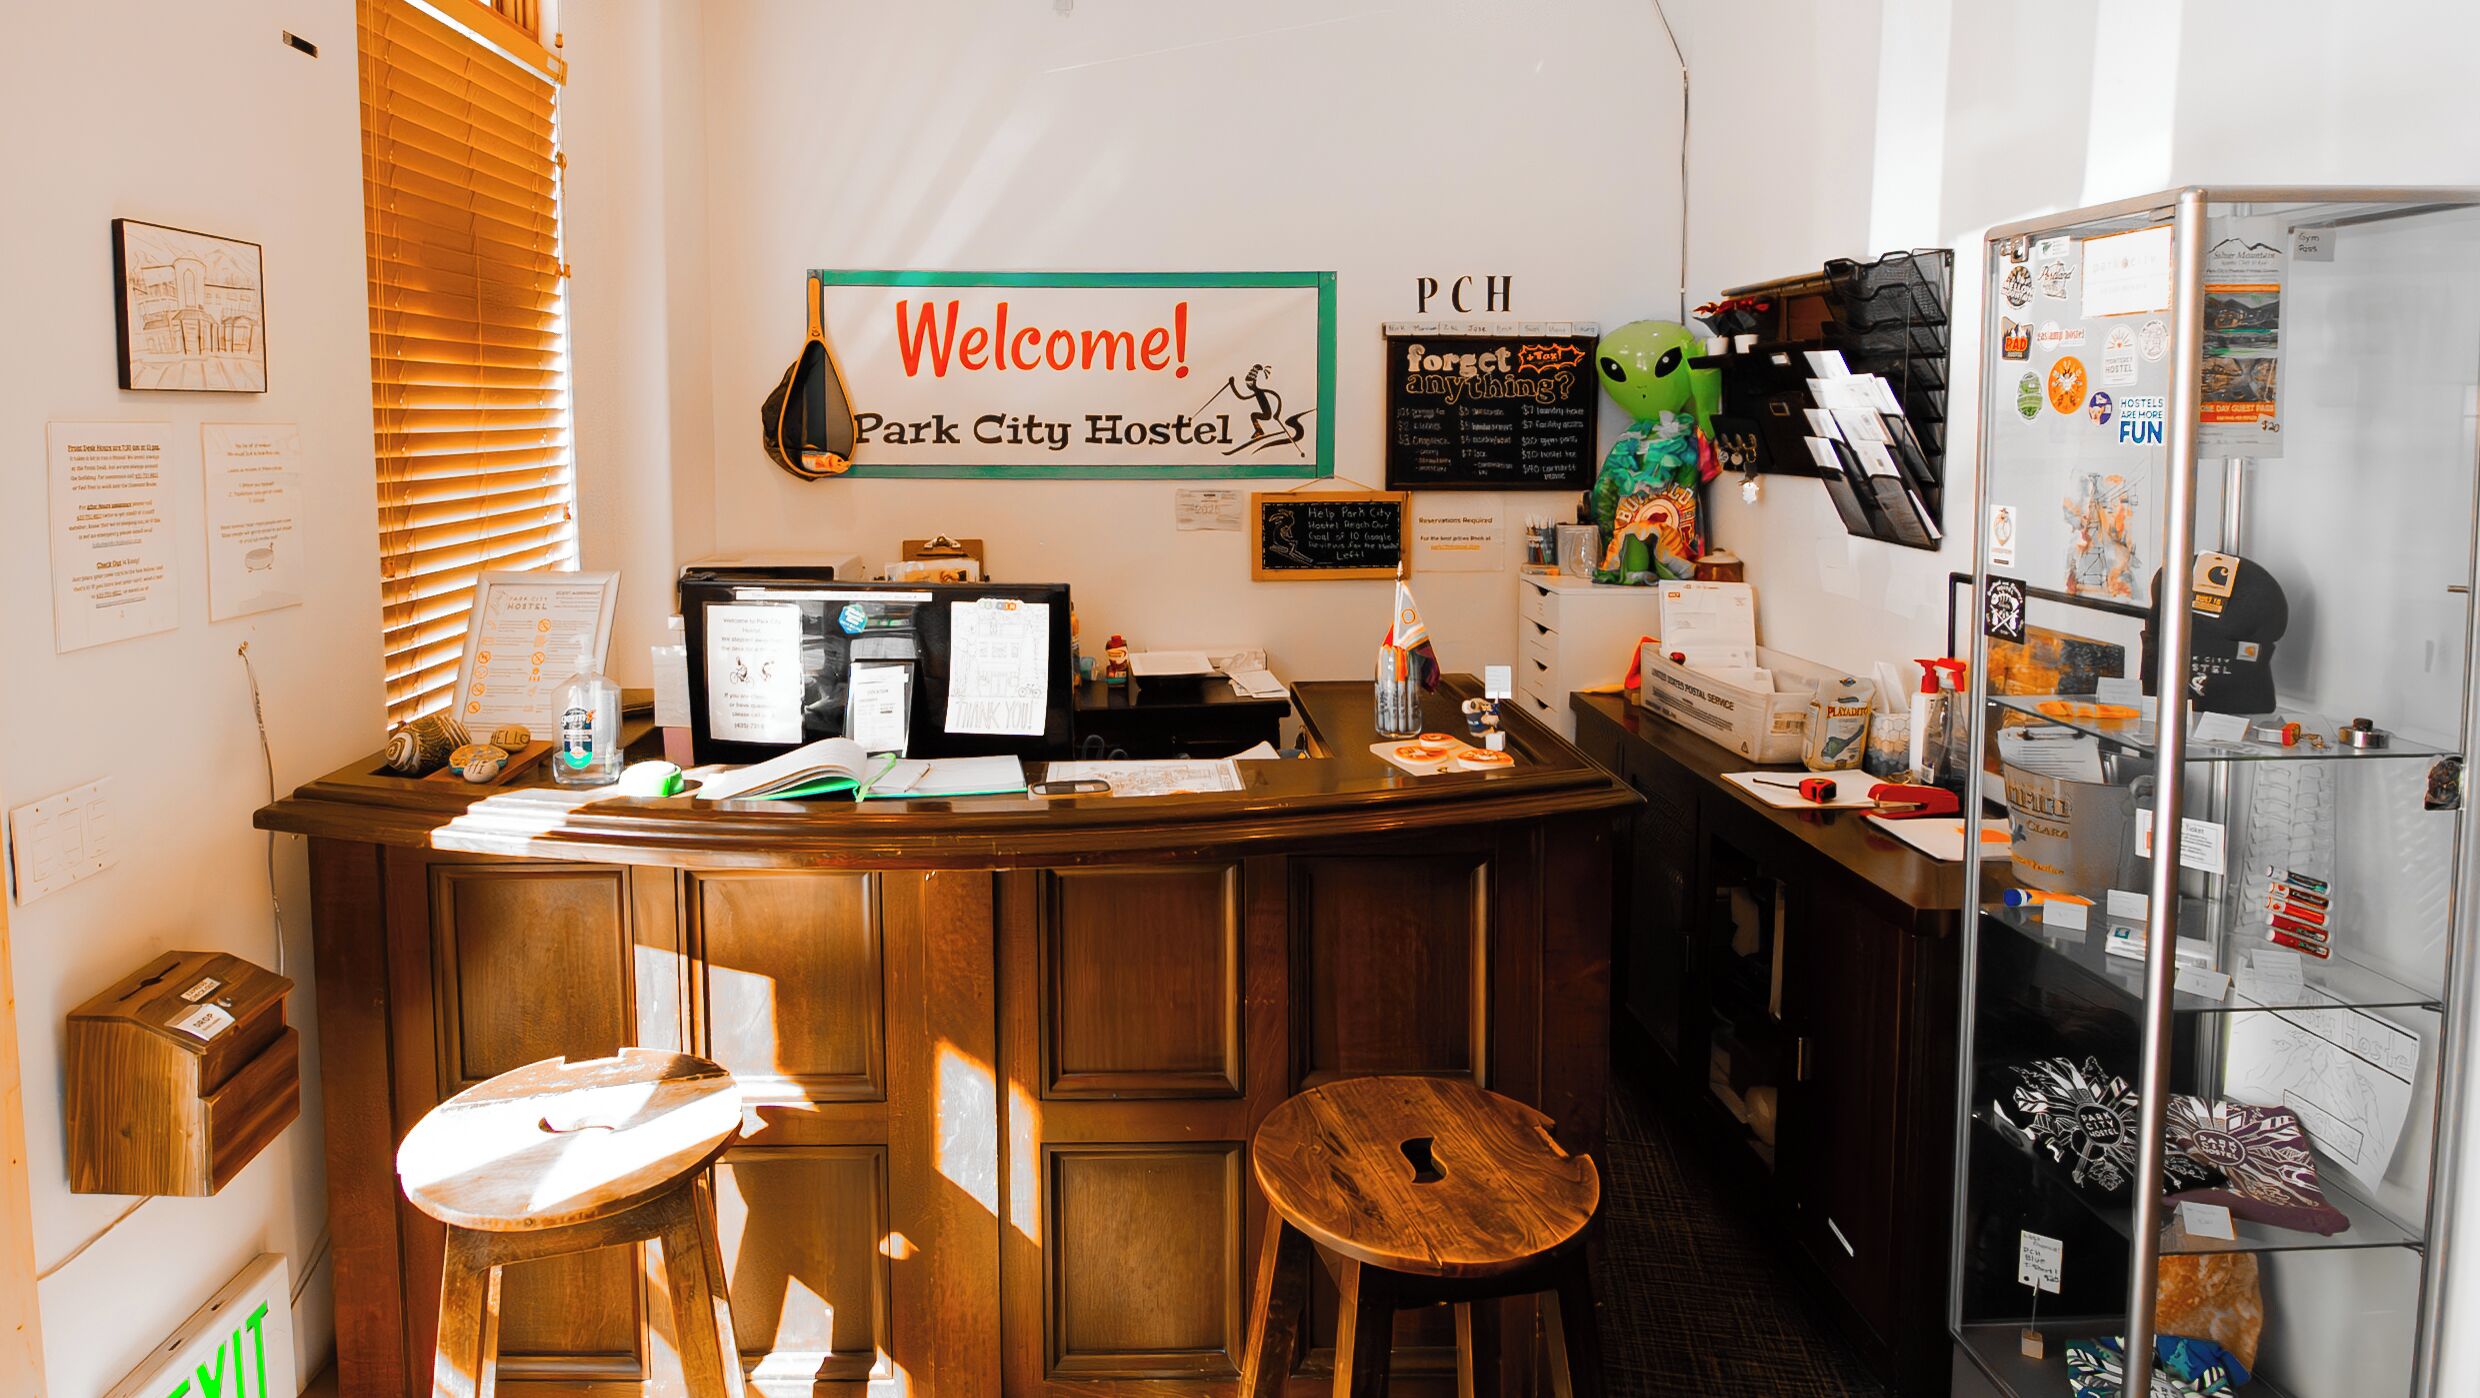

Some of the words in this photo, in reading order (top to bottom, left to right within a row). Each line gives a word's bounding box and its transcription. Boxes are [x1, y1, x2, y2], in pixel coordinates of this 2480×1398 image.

[896, 299, 1189, 380] Welcome!
[1407, 344, 1512, 378] forget
[2104, 364, 2133, 373] HOSTEL
[1406, 370, 1576, 405] anything?
[2120, 398, 2164, 409] HOSTELS
[2231, 404, 2256, 413] GUEST
[2120, 410, 2136, 419] ARE
[2138, 410, 2163, 419] MORE
[854, 412, 961, 446] Park
[972, 412, 1072, 451] City
[1084, 412, 1235, 446] Hostel
[2119, 420, 2163, 444] FUN
[1308, 508, 1338, 521] Help
[1341, 506, 1367, 520] Park
[1369, 507, 1393, 522] City
[1308, 521, 1339, 530] Hostel
[1343, 519, 1371, 530] Reach
[1372, 519, 1390, 530] Our
[1418, 517, 1462, 525] Reservations
[1462, 517, 1494, 526] Required
[1308, 531, 1331, 542] Goal
[1336, 532, 1346, 542] of
[1350, 531, 1360, 542] 10
[1364, 531, 1393, 543] Google
[507, 602, 549, 610] HOSTEL
[1667, 675, 1685, 691] STATES
[1684, 682, 1707, 701] POSTAL
[1706, 693, 1735, 712] SERVICE
[955, 700, 1001, 730] THANK
[1004, 699, 1035, 731] YOU!
[1826, 705, 1868, 719] PLAYADITO
[2026, 818, 2069, 840] CLARA
[2080, 1111, 2112, 1123] PARK
[2085, 1119, 2115, 1130] CITY
[2088, 1127, 2119, 1139] HOSTEL
[2199, 1135, 2236, 1151] PARK
[2201, 1142, 2236, 1154] CITY
[2202, 1147, 2239, 1162] HOSTEL
[168, 1298, 270, 1398] XIT
